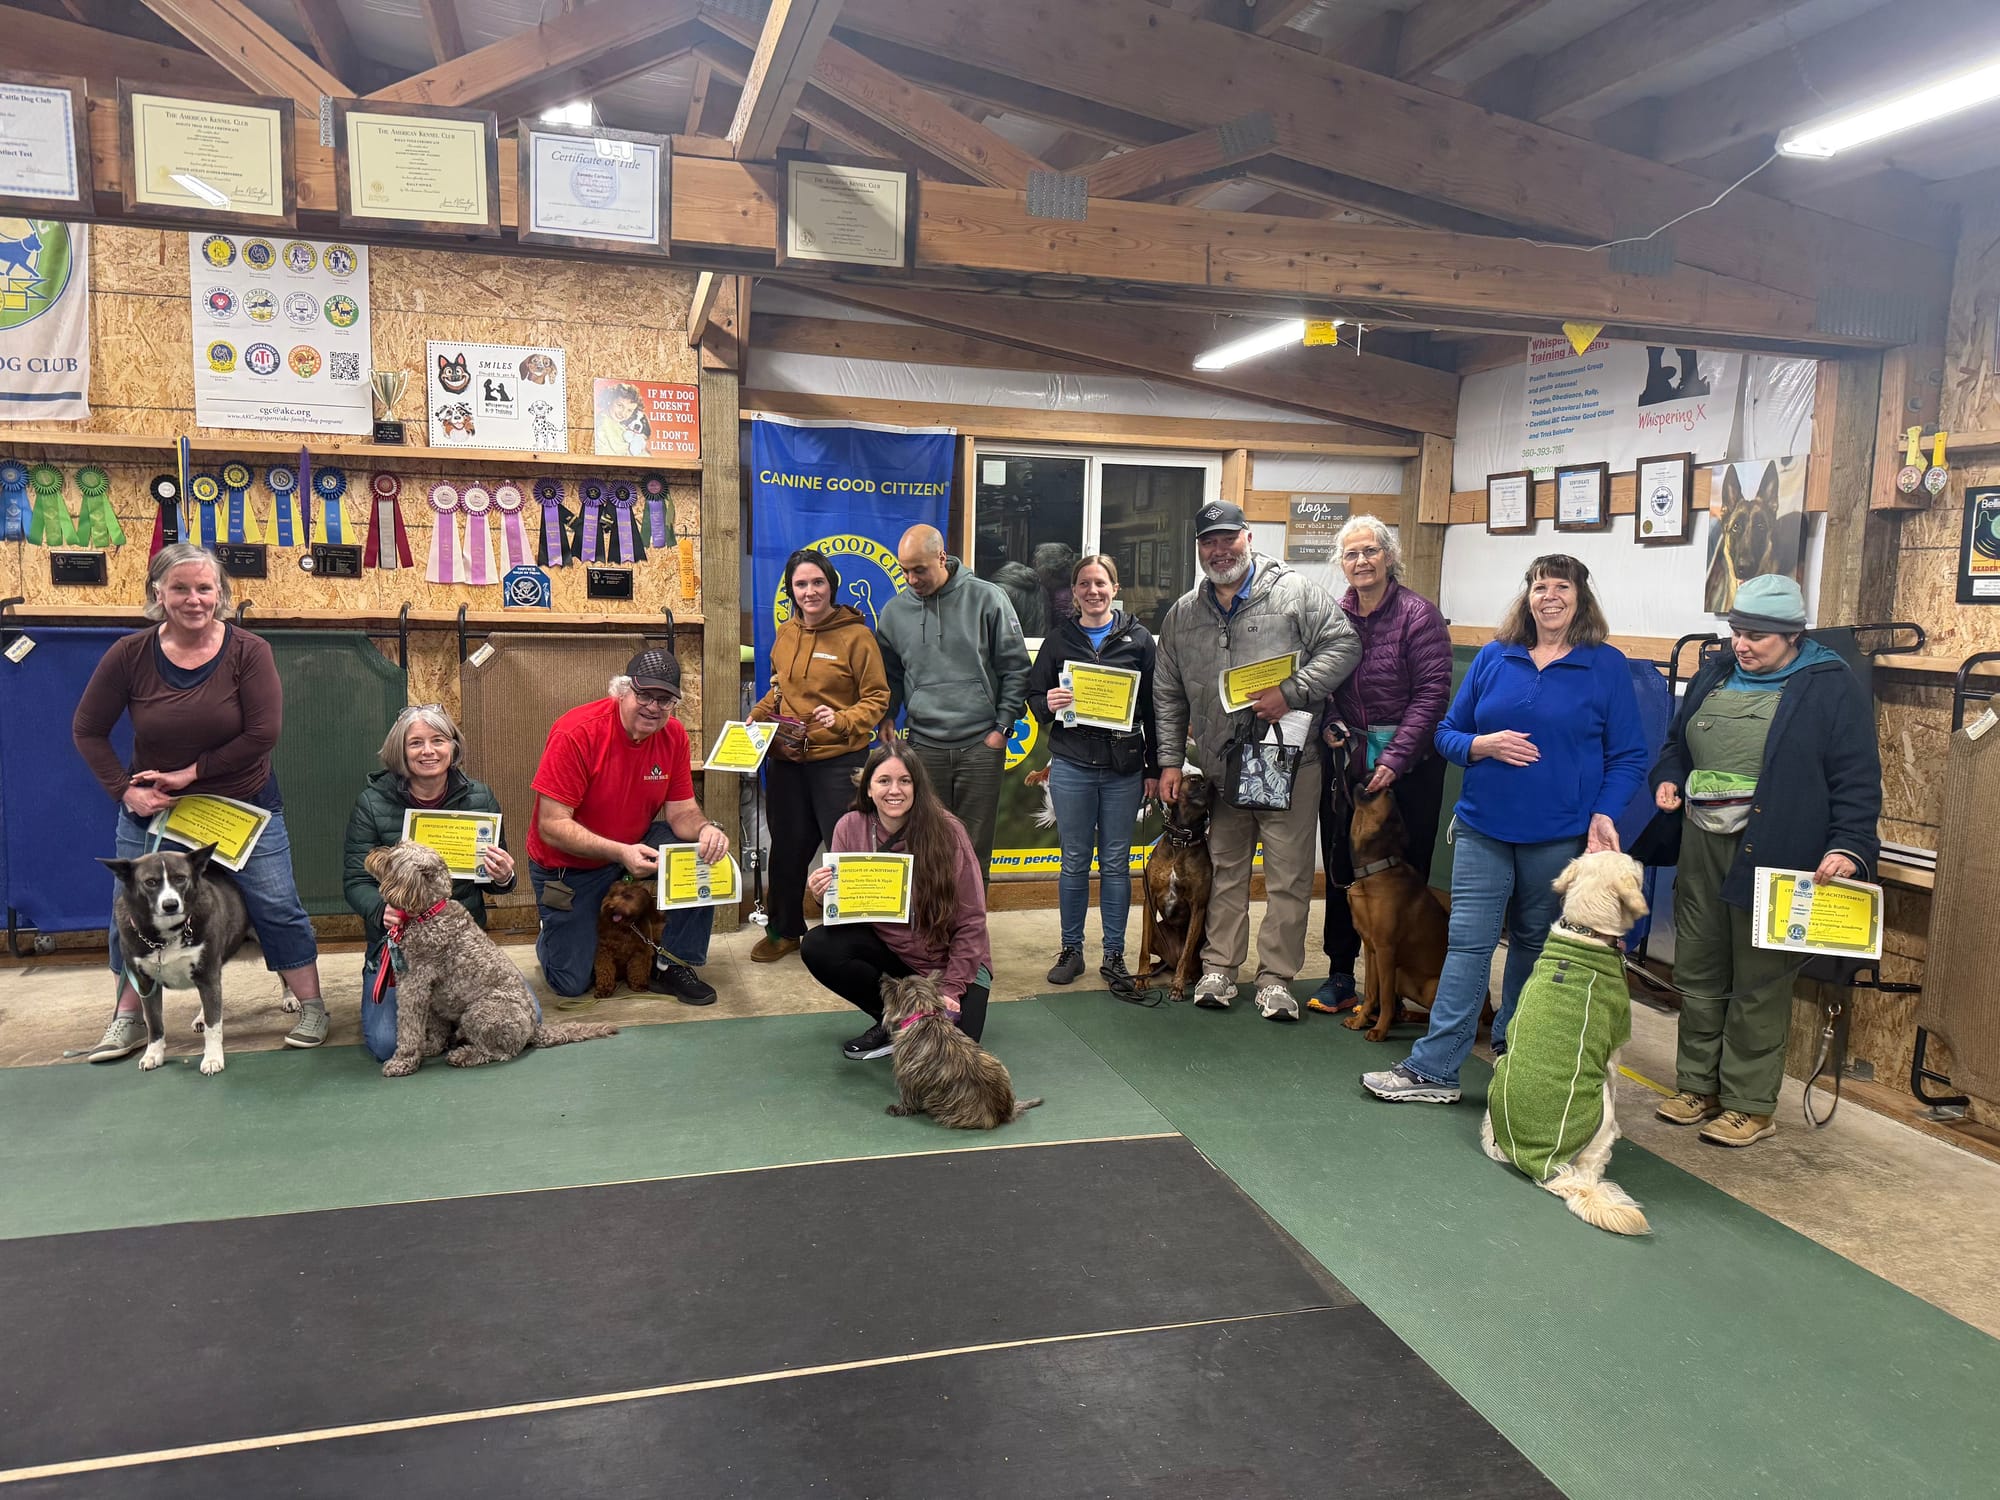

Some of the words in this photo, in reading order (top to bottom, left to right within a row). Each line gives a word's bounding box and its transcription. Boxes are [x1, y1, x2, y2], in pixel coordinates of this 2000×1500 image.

[552, 150, 601, 165] Certificate
[255, 351, 270, 364] ATT
[1531, 349, 1565, 364] Training
[27, 358, 78, 373] CLUB
[479, 361, 513, 370] SMILES
[648, 389, 657, 399] IF
[660, 390, 674, 399] MY
[676, 391, 694, 400] DOG
[260, 407, 311, 417] cgc@akc.org
[653, 401, 690, 411] DOESN'T
[650, 412, 673, 422] LIKE
[675, 414, 696, 424] YOU,
[1582, 412, 1596, 420] Good
[1639, 409, 1694, 433] Whispering
[1696, 404, 1707, 420] X
[656, 430, 660, 439] I
[662, 430, 689, 440] DON'T
[651, 441, 673, 450] LIKE
[676, 442, 696, 452] YOU.
[760, 470, 822, 490] CANINE
[826, 478, 876, 493] GOOD
[880, 482, 944, 496] CITIZEN
[1297, 497, 1331, 522] dogs
[817, 538, 875, 556] GOOD
[991, 855, 1020, 865] ving
[1024, 854, 1060, 865] perfo
